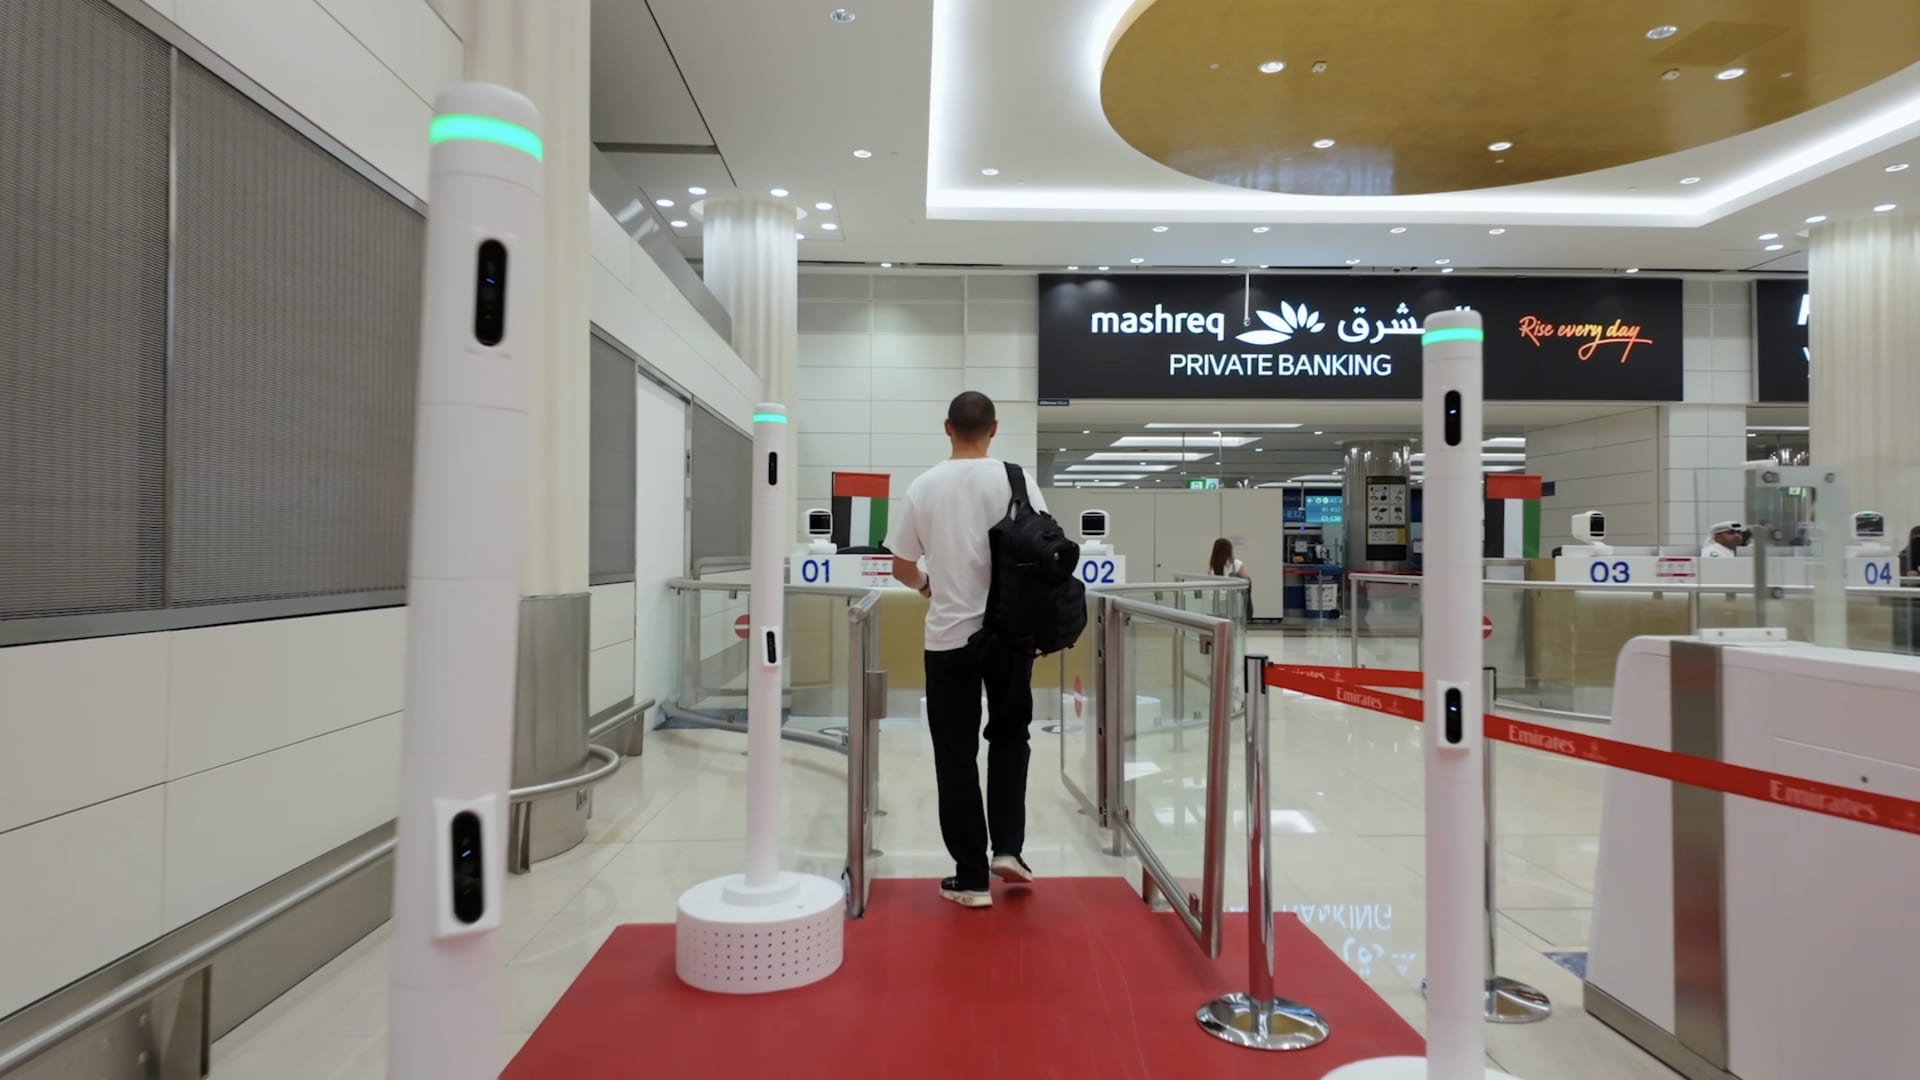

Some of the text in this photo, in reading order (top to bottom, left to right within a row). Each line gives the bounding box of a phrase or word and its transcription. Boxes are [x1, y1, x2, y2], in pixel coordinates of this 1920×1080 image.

[1091, 304, 1225, 342] mashreq
[1519, 315, 1645, 363] Rise every day
[1169, 353, 1393, 376] PRIVATE BANKING
[801, 559, 831, 584] 01
[1081, 560, 1115, 584] 02
[1590, 561, 1630, 583] 03
[1864, 562, 1892, 585] 04
[1335, 686, 1383, 710] Emirates
[1508, 724, 1576, 755] Emirates
[1768, 779, 1879, 820] Emirates
